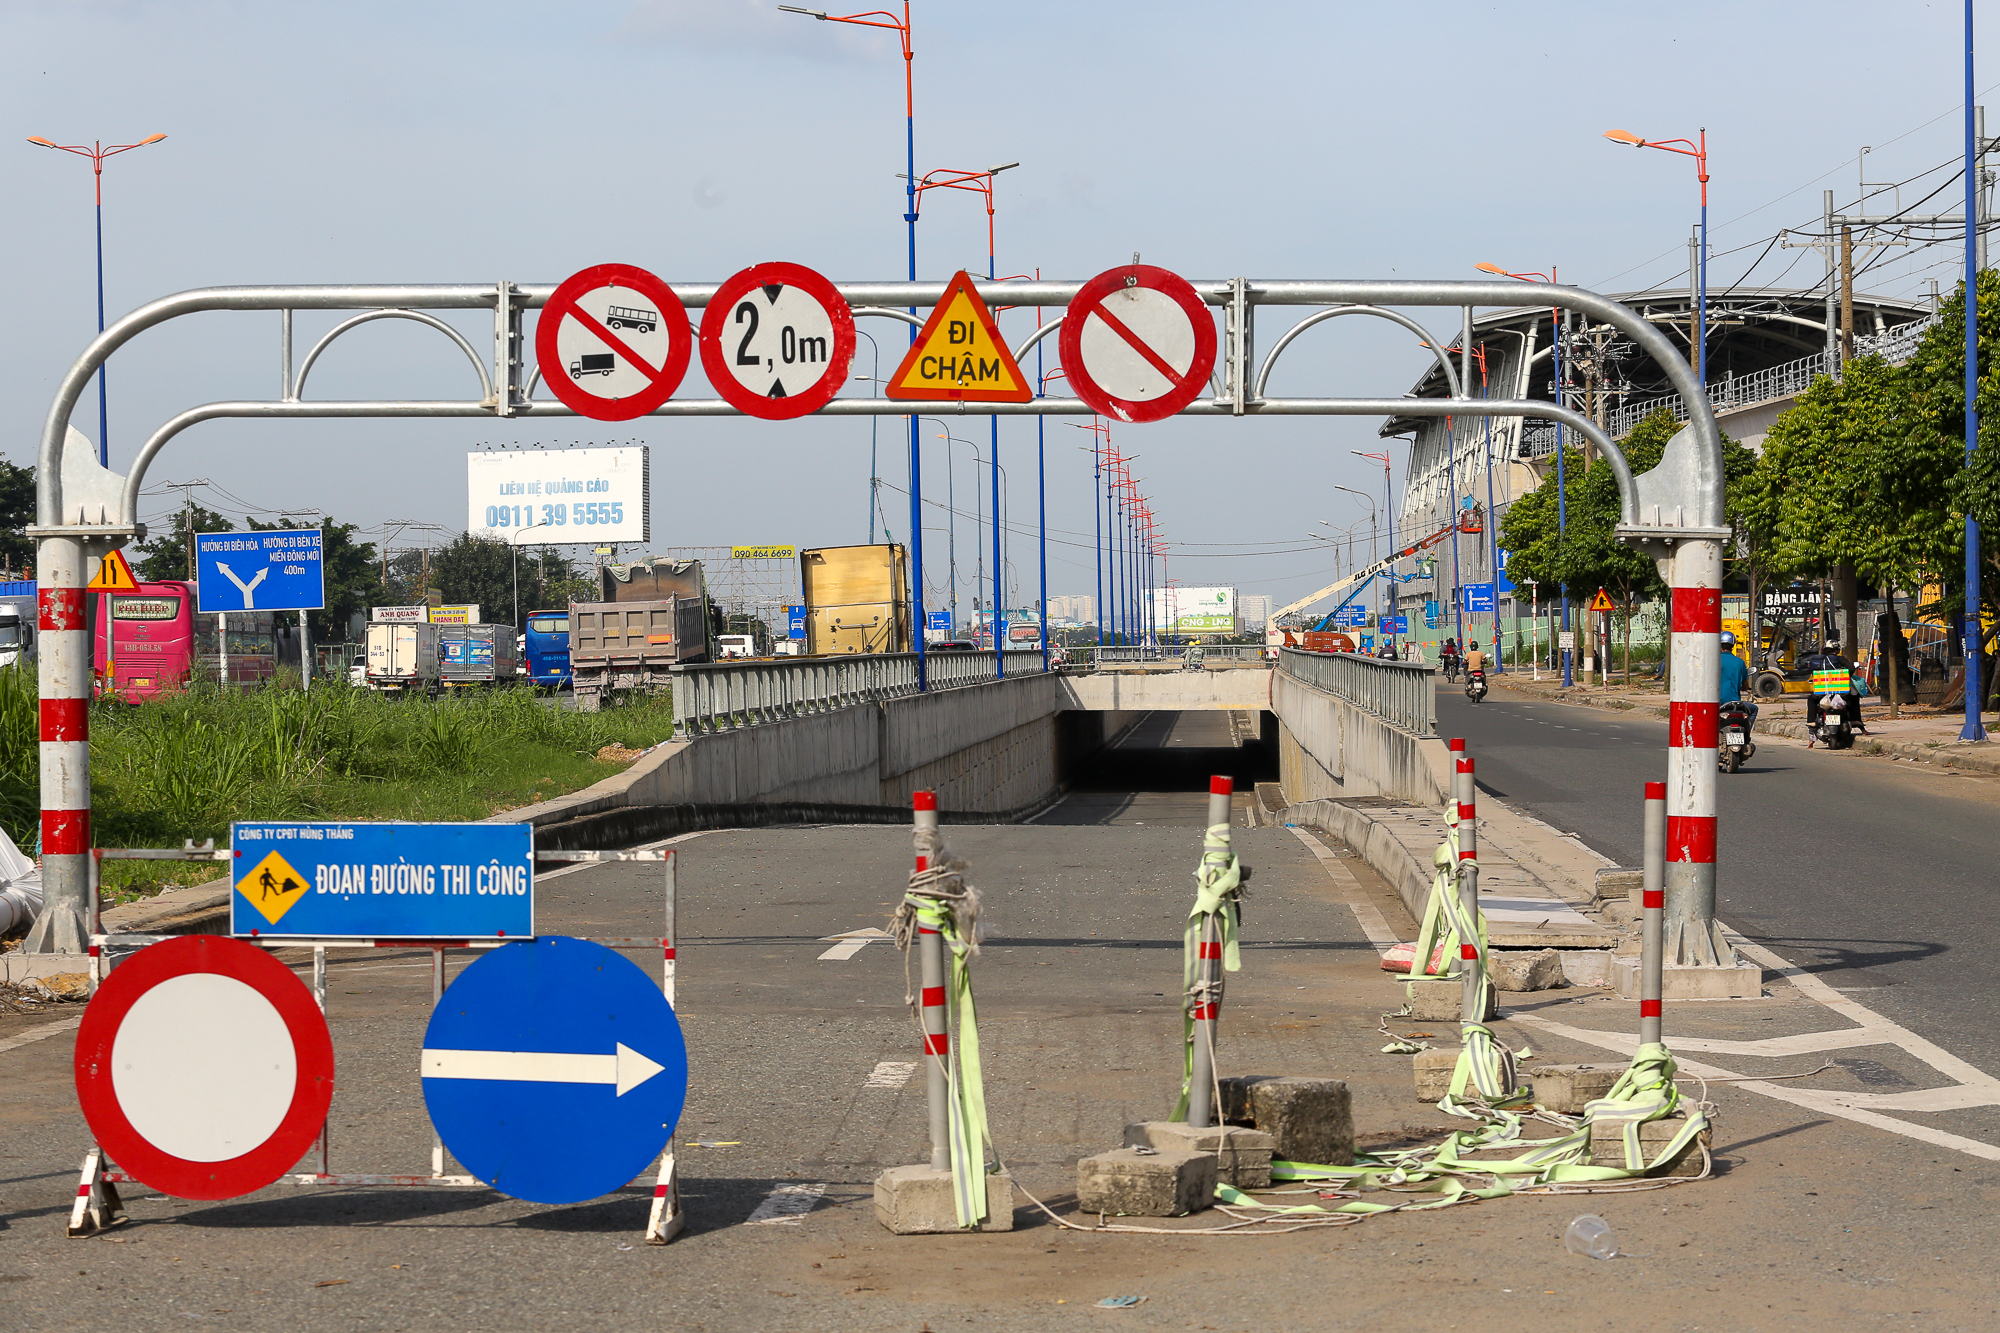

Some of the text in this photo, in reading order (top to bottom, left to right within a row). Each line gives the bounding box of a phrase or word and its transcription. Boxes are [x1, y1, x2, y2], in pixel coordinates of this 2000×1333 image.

[736, 302, 826, 373] 2,0m
[948, 321, 974, 345] ĐI
[921, 351, 999, 386] CHẬM
[500, 477, 609, 497] LIÊN HỆ QUẢNG CÁO
[486, 502, 623, 527] 0911 39 5555
[201, 537, 259, 552] HƯỚNG ĐI BIÊN HÒA
[263, 536, 288, 548] HƯỚNG
[289, 537, 296, 547] ĐI
[312, 536, 321, 547] XE
[287, 549, 305, 561] ĐÔNG
[307, 548, 319, 560] MỚI
[735, 550, 750, 558] 090
[771, 549, 792, 557] 6699
[284, 565, 305, 575] 400m
[1354, 563, 1382, 581] JLG LIFT
[1181, 618, 1204, 626] CNG
[1212, 618, 1231, 626] LNG
[238, 827, 262, 840] CÔNG
[263, 829, 275, 839] TY
[276, 828, 298, 839] CPĐT
[299, 826, 324, 840] HÙNG
[315, 856, 526, 901] ĐOẠN ĐƯỜNG THI CÔNG
